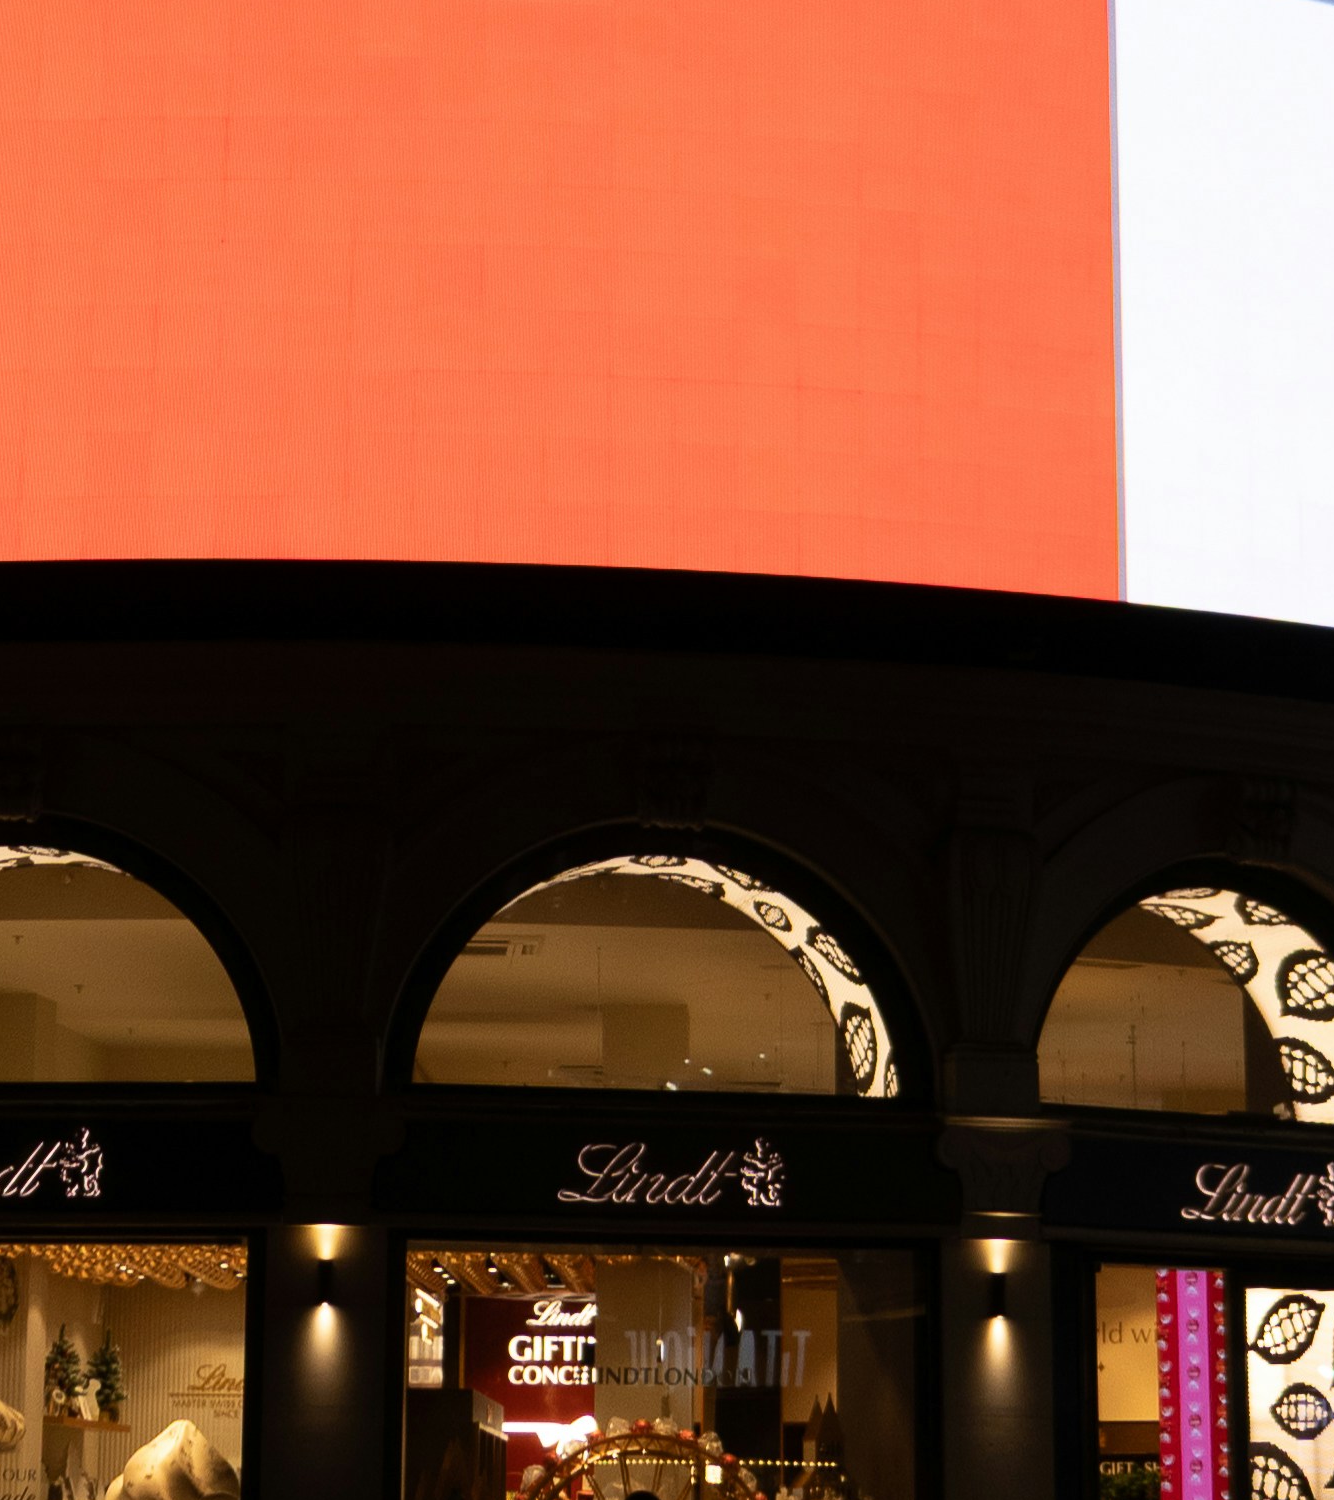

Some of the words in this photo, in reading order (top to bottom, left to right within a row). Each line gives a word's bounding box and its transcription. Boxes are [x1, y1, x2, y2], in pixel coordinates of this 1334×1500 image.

[557, 1141, 738, 1205] Lindt
[1180, 1162, 1316, 1226] Lindt
[526, 1300, 598, 1327] Lindt
[2, 1467, 37, 1482] OUR
